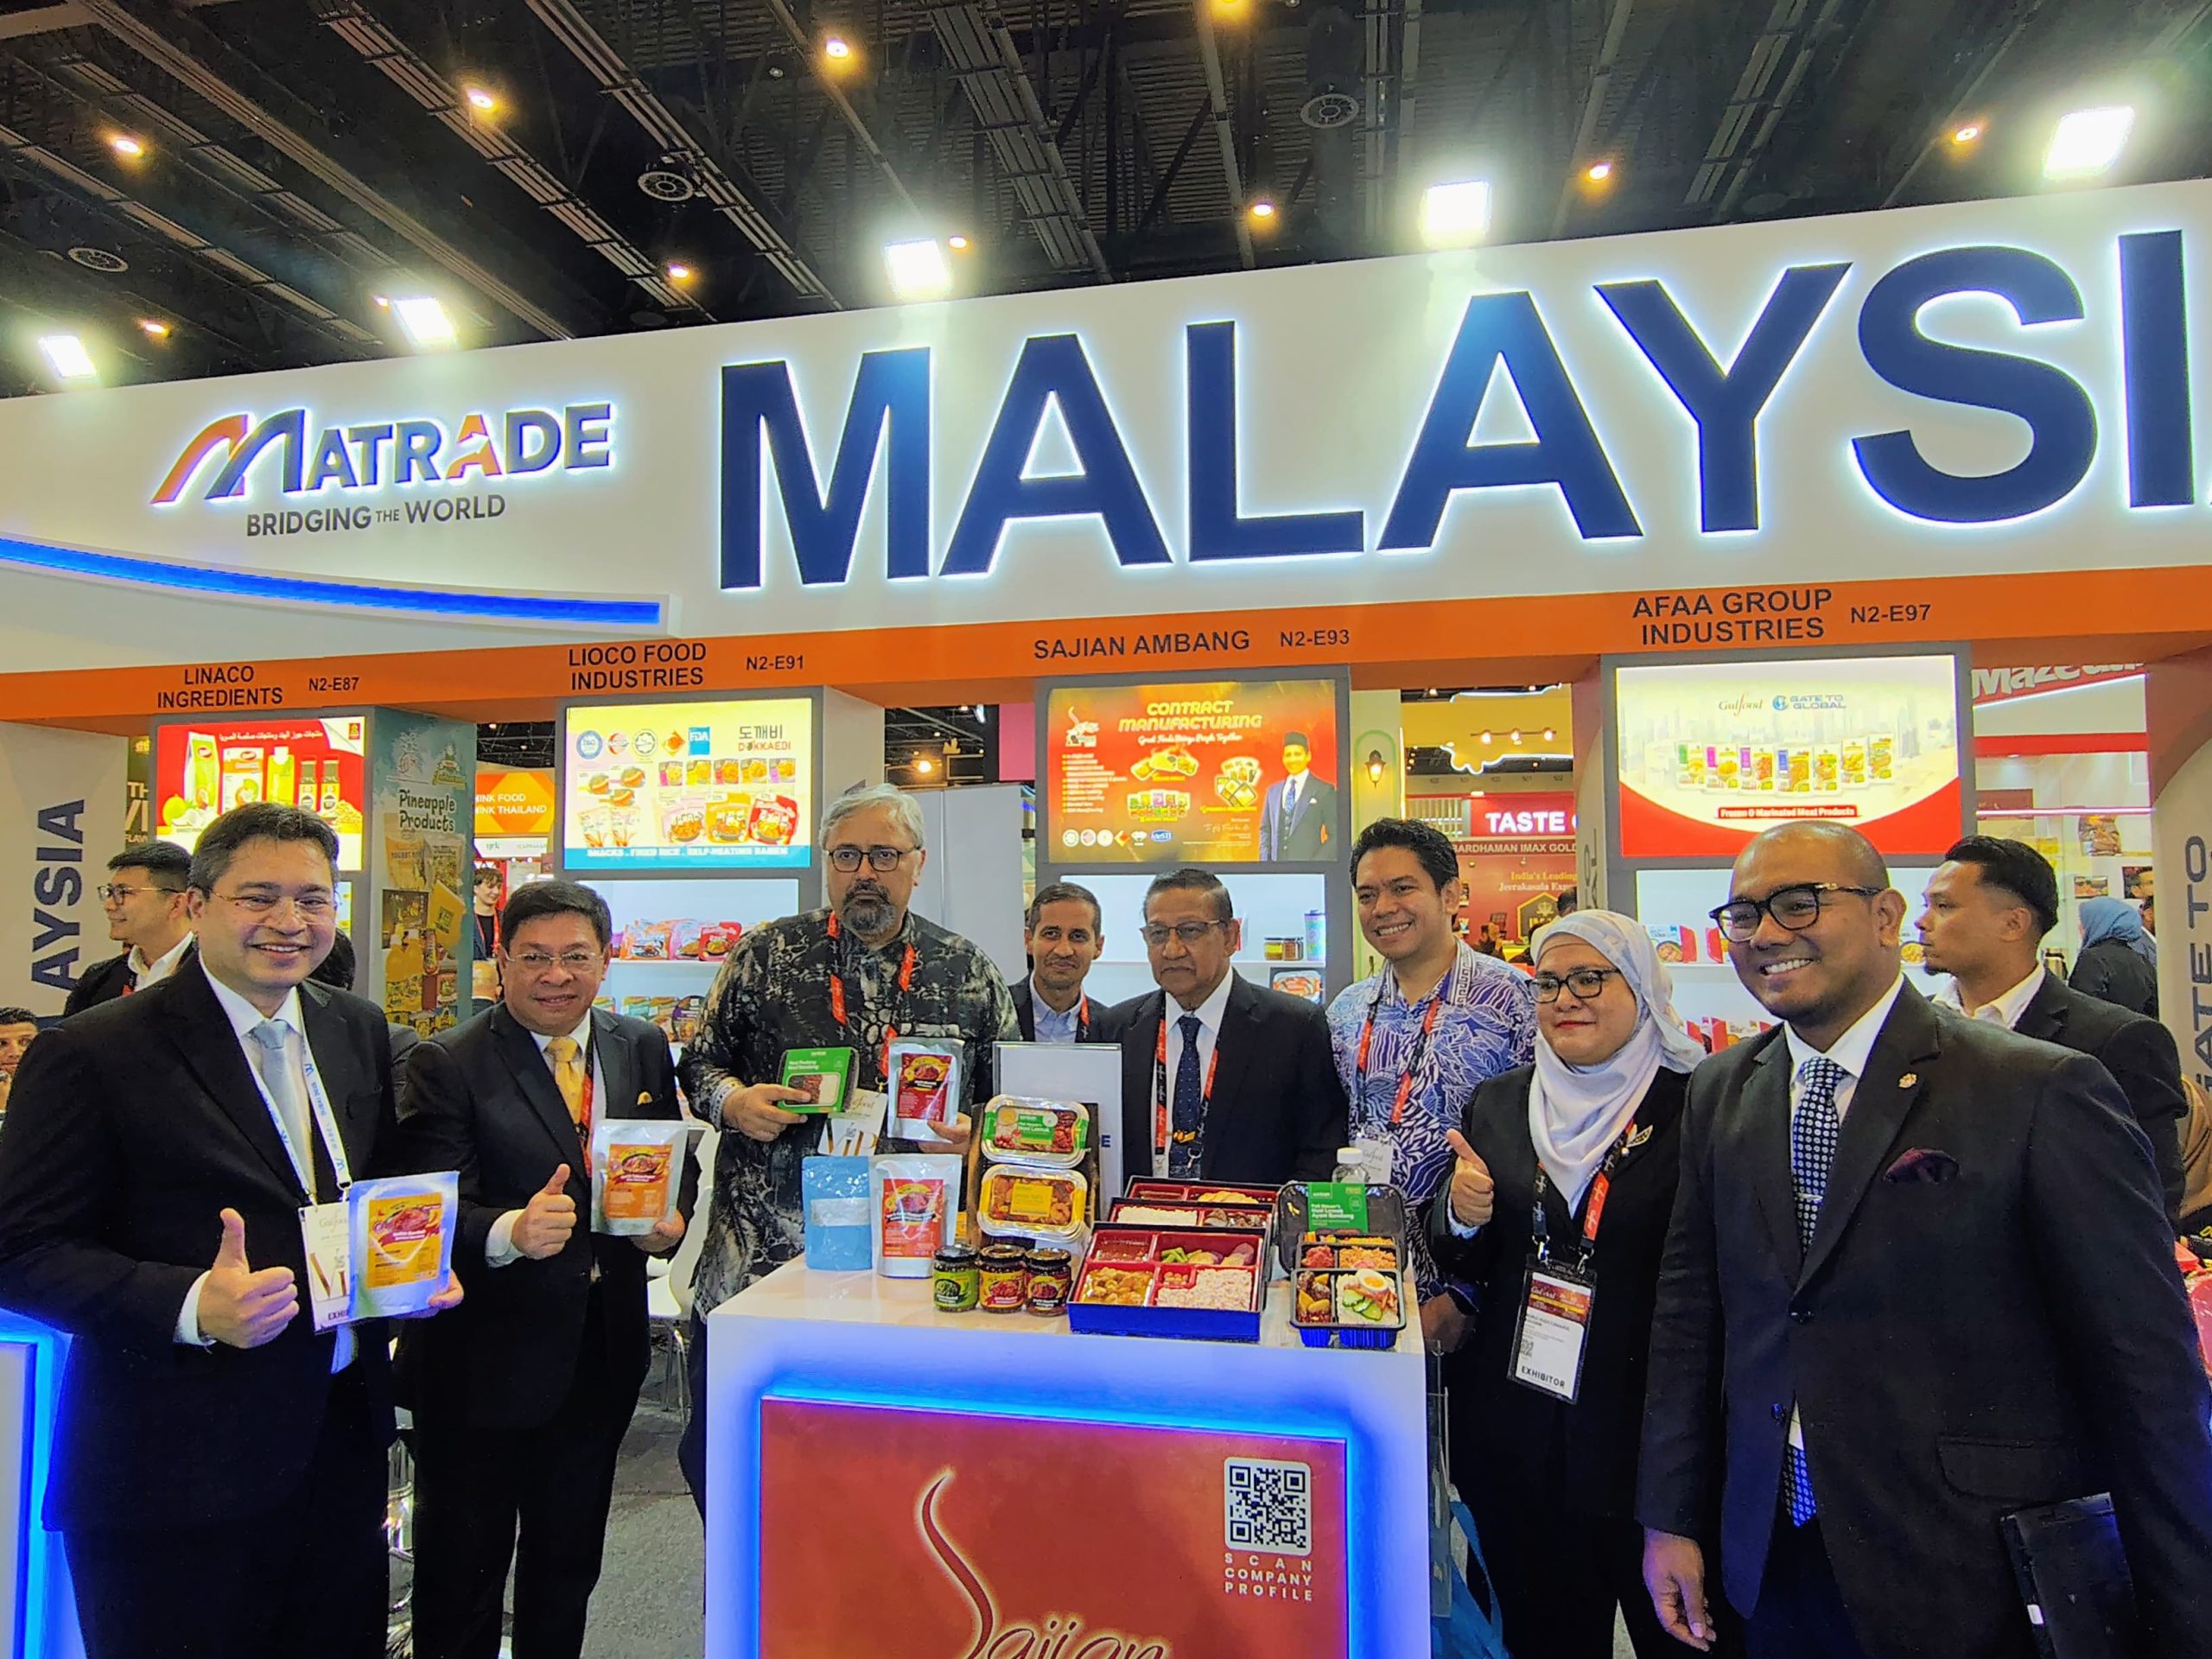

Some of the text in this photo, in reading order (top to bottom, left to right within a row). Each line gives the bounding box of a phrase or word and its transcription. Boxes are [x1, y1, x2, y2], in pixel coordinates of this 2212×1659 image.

[721, 229, 2212, 589] MALAYSI
[149, 403, 612, 505] MATRADE
[247, 494, 505, 537] BRIDGING THE WORLD
[1633, 588, 1832, 618] AFAA GROUP
[1851, 604, 1931, 623] N2-E97
[1280, 629, 1351, 647] N2-E93
[1642, 617, 1825, 645] INDUSTRIES
[569, 642, 707, 666] LIOCO FOOD
[1034, 630, 1250, 659] SAJIAN AMBANG
[746, 655, 804, 671] N2-E91
[184, 665, 254, 685] LINACO
[308, 677, 359, 691] N2-E87
[571, 667, 704, 690] INDUSTRIES
[157, 687, 283, 708] INGREDIENTS
[1147, 700, 1234, 715] CONTRACT
[1118, 715, 1262, 732] MANUFACTURING
[399, 789, 454, 815] Pineapple
[498, 793, 525, 802] FOOD
[498, 804, 546, 814] THAILAND
[399, 810, 454, 831] Products
[1485, 811, 1565, 834] TASTE
[1521, 843, 1547, 853] IMAX
[2185, 836, 2209, 929] TO
[1521, 1365, 1566, 1389] EXHIBITOR
[1224, 1552, 1312, 1572] SCAN
[1224, 1567, 1312, 1586] COMPANY
[1224, 1581, 1313, 1602] PROFILE
